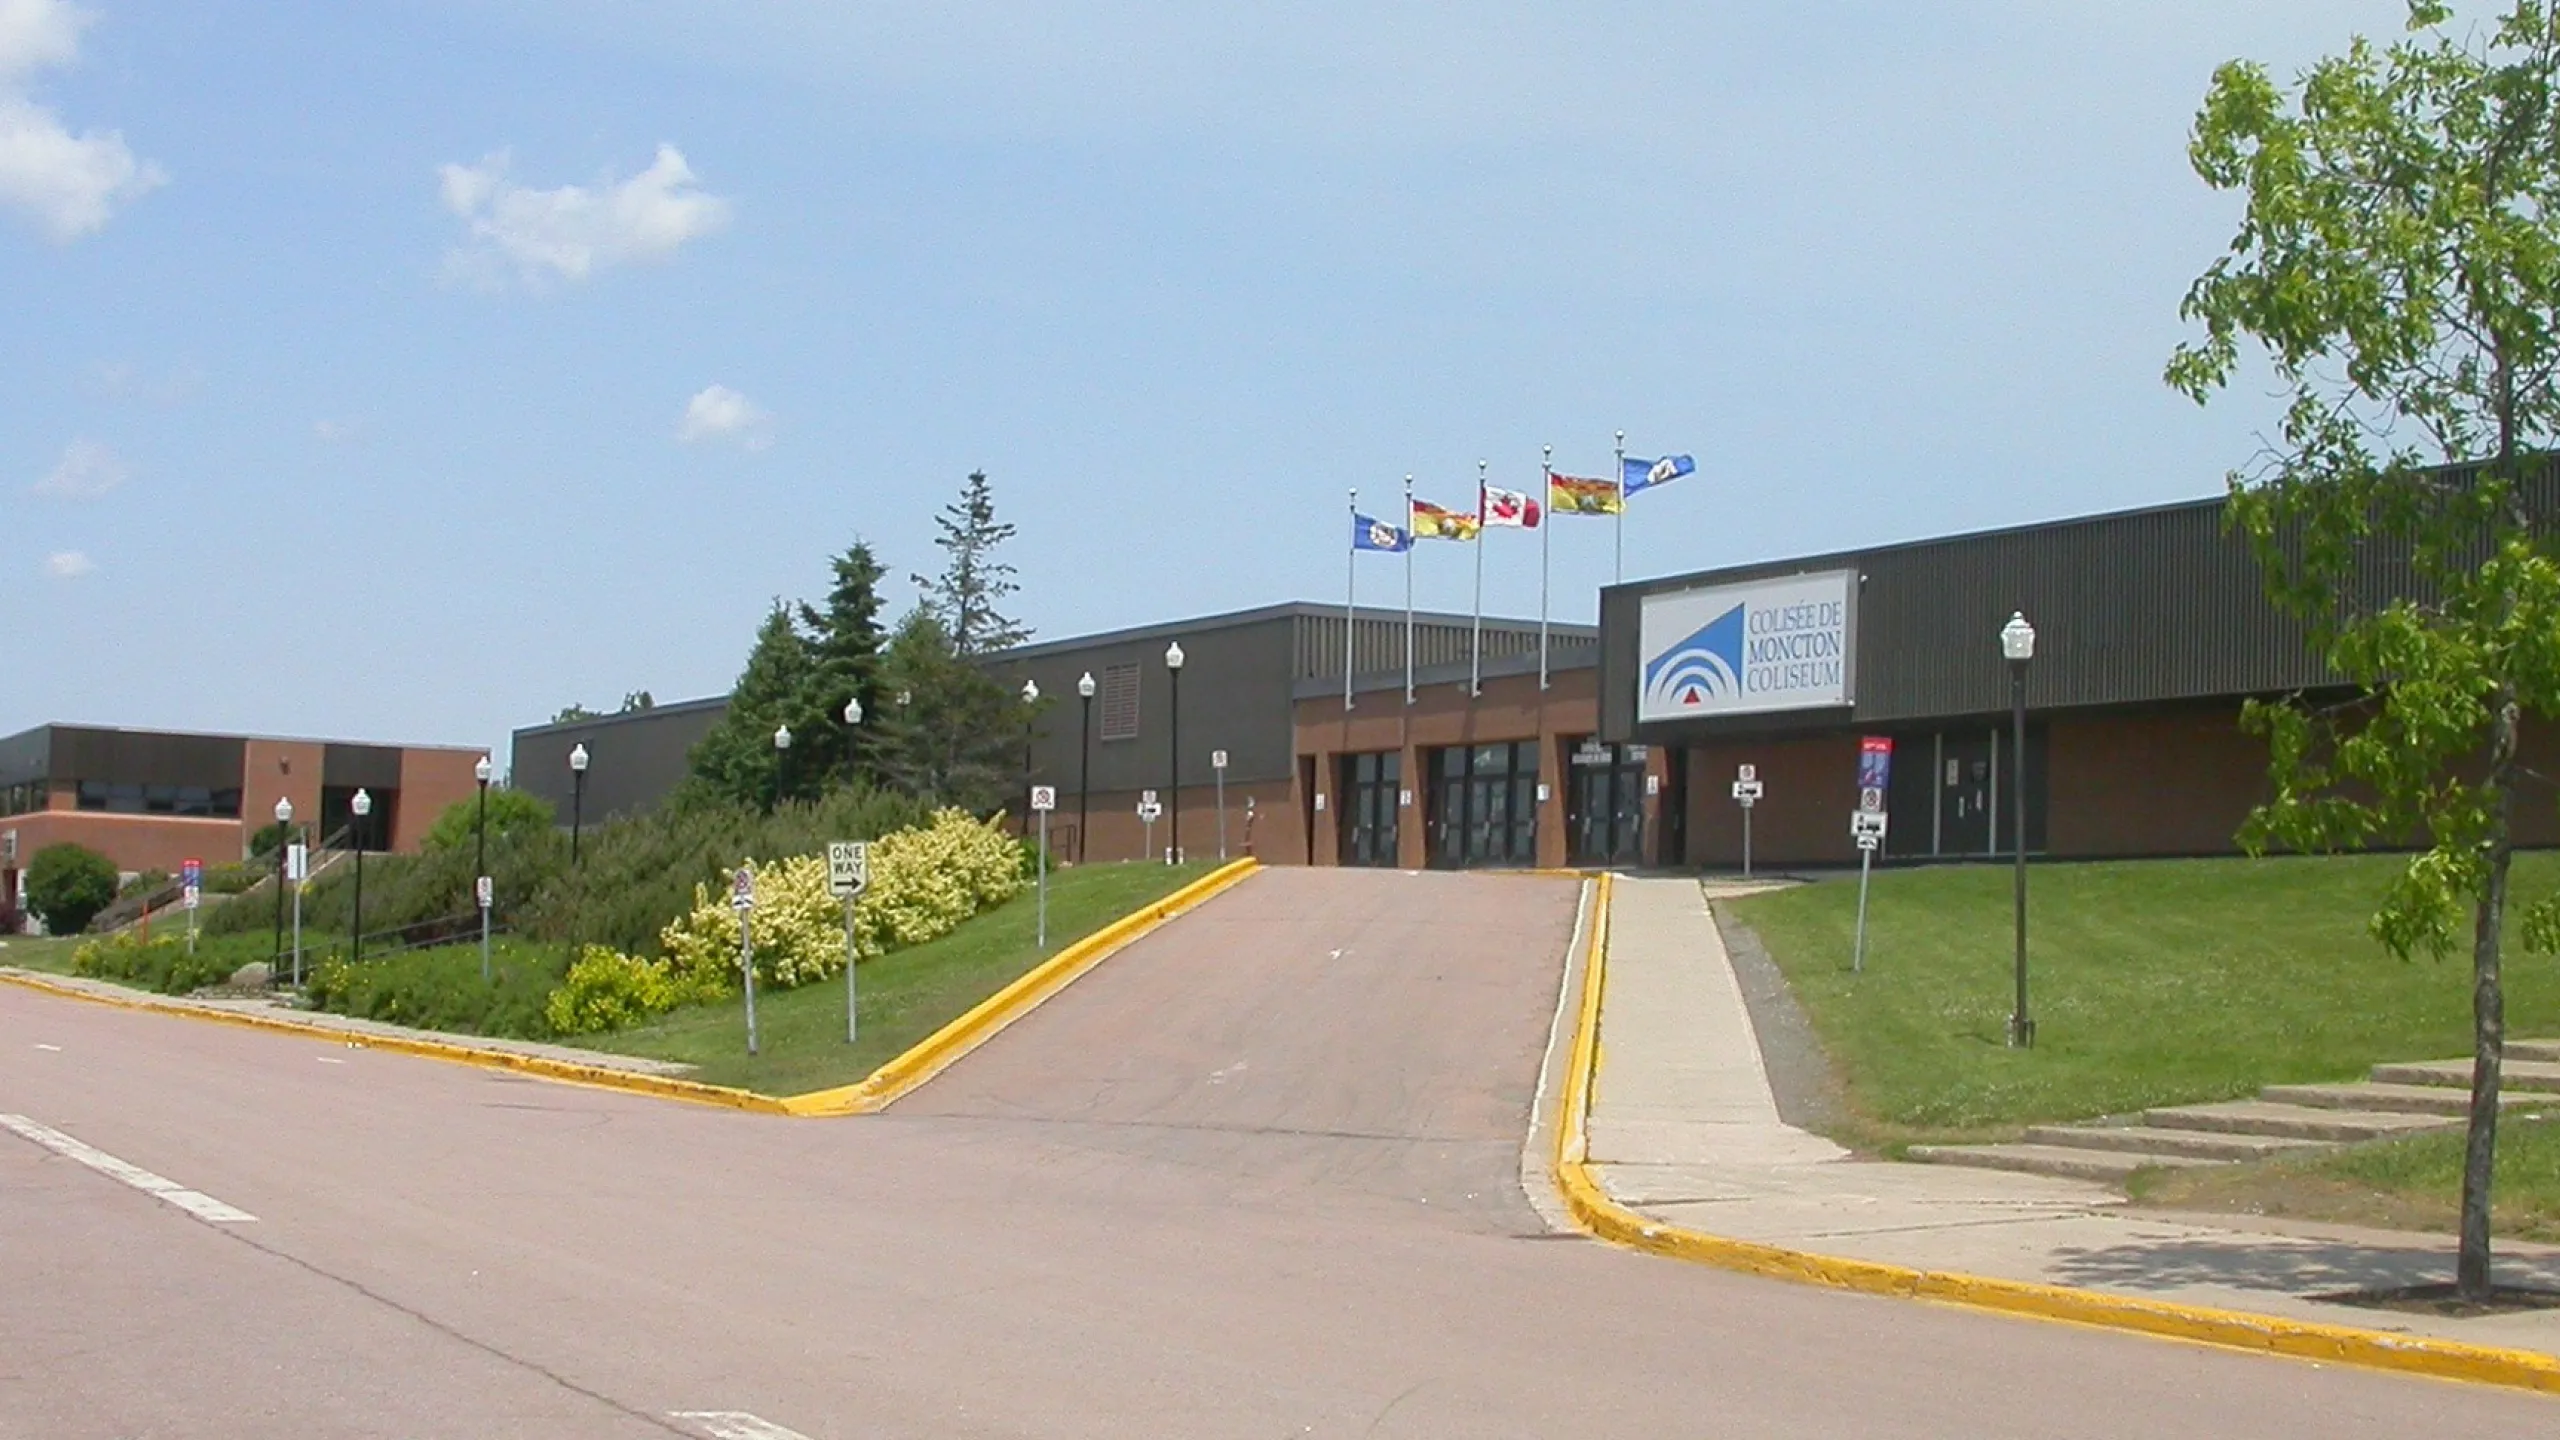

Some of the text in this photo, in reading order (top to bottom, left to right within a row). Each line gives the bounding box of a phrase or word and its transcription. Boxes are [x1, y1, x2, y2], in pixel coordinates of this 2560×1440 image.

[1749, 599, 1842, 634] COLISÉE DE
[1749, 631, 1841, 665] MONCTON
[1747, 660, 1841, 692] COLISEUM
[832, 845, 862, 859] ONE
[833, 861, 863, 874] WAY
